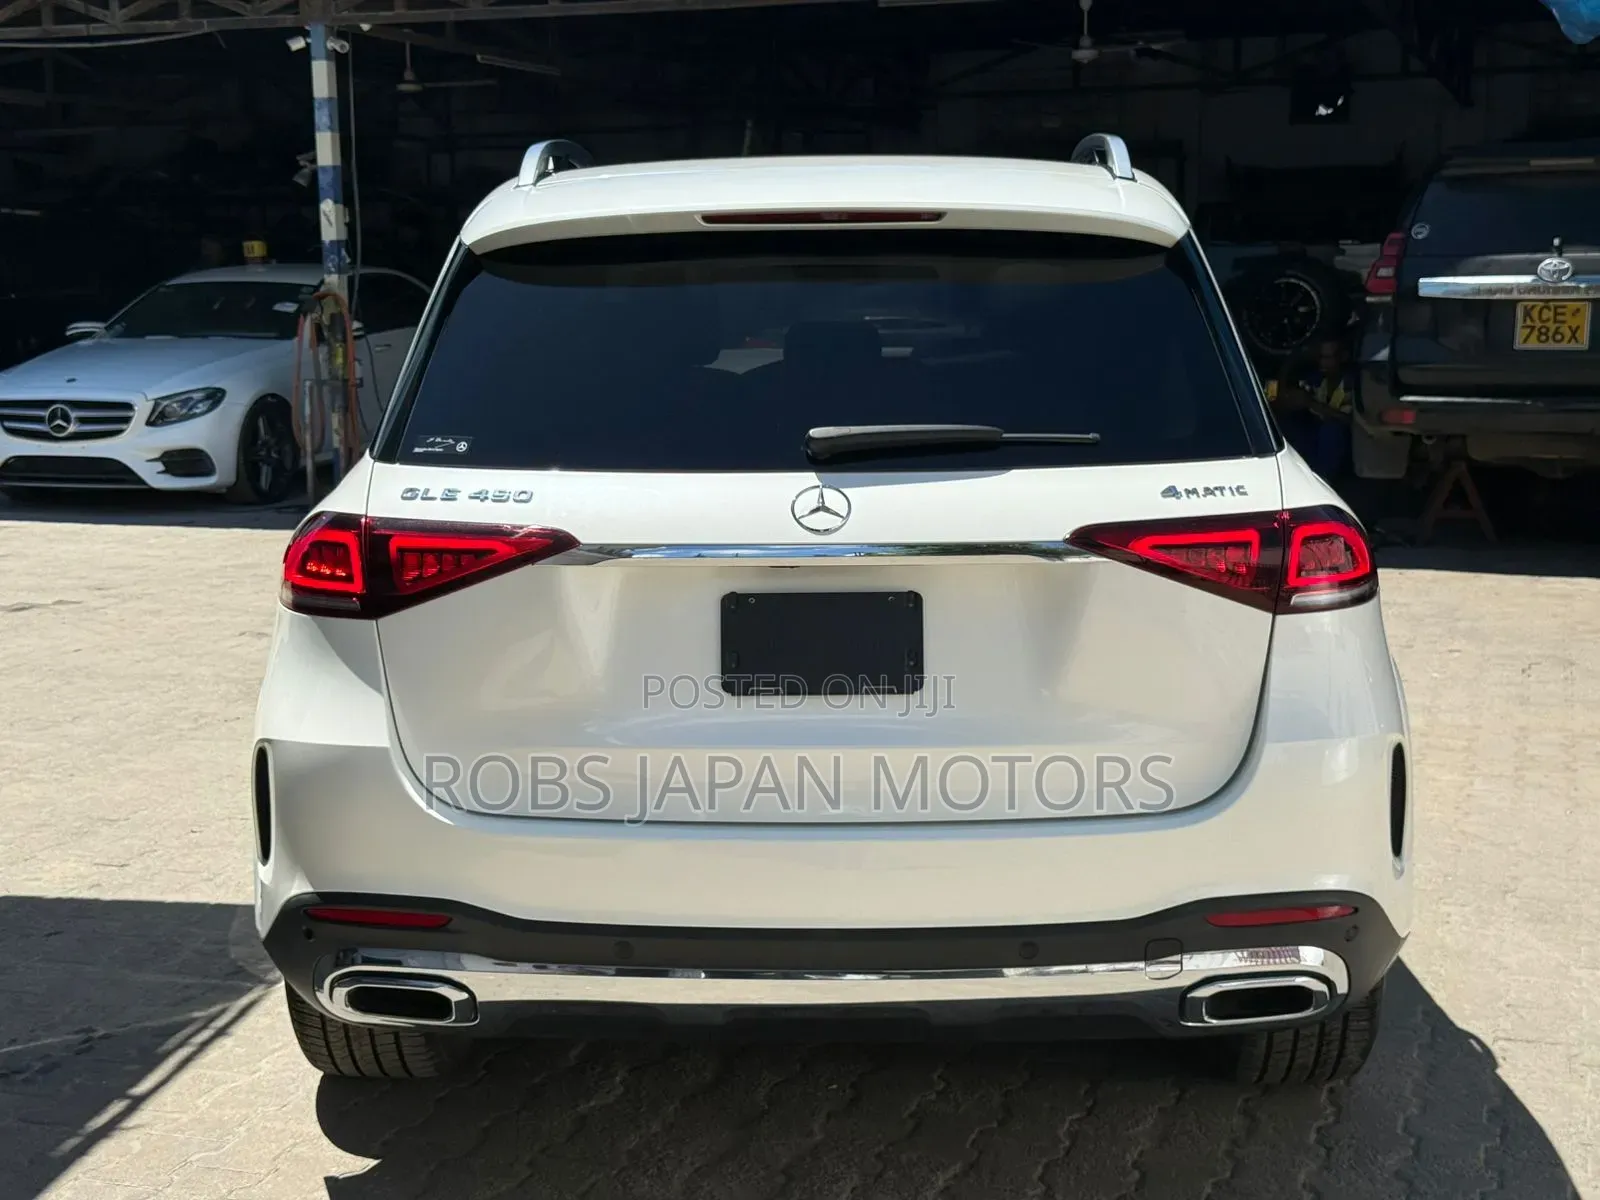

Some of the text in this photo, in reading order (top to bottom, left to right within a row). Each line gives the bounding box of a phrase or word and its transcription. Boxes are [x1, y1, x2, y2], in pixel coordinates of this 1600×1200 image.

[1522, 304, 1567, 324] KCE
[1521, 325, 1580, 344] 786X
[400, 487, 534, 503] GLE 450
[1160, 485, 1248, 500] 4MATIC
